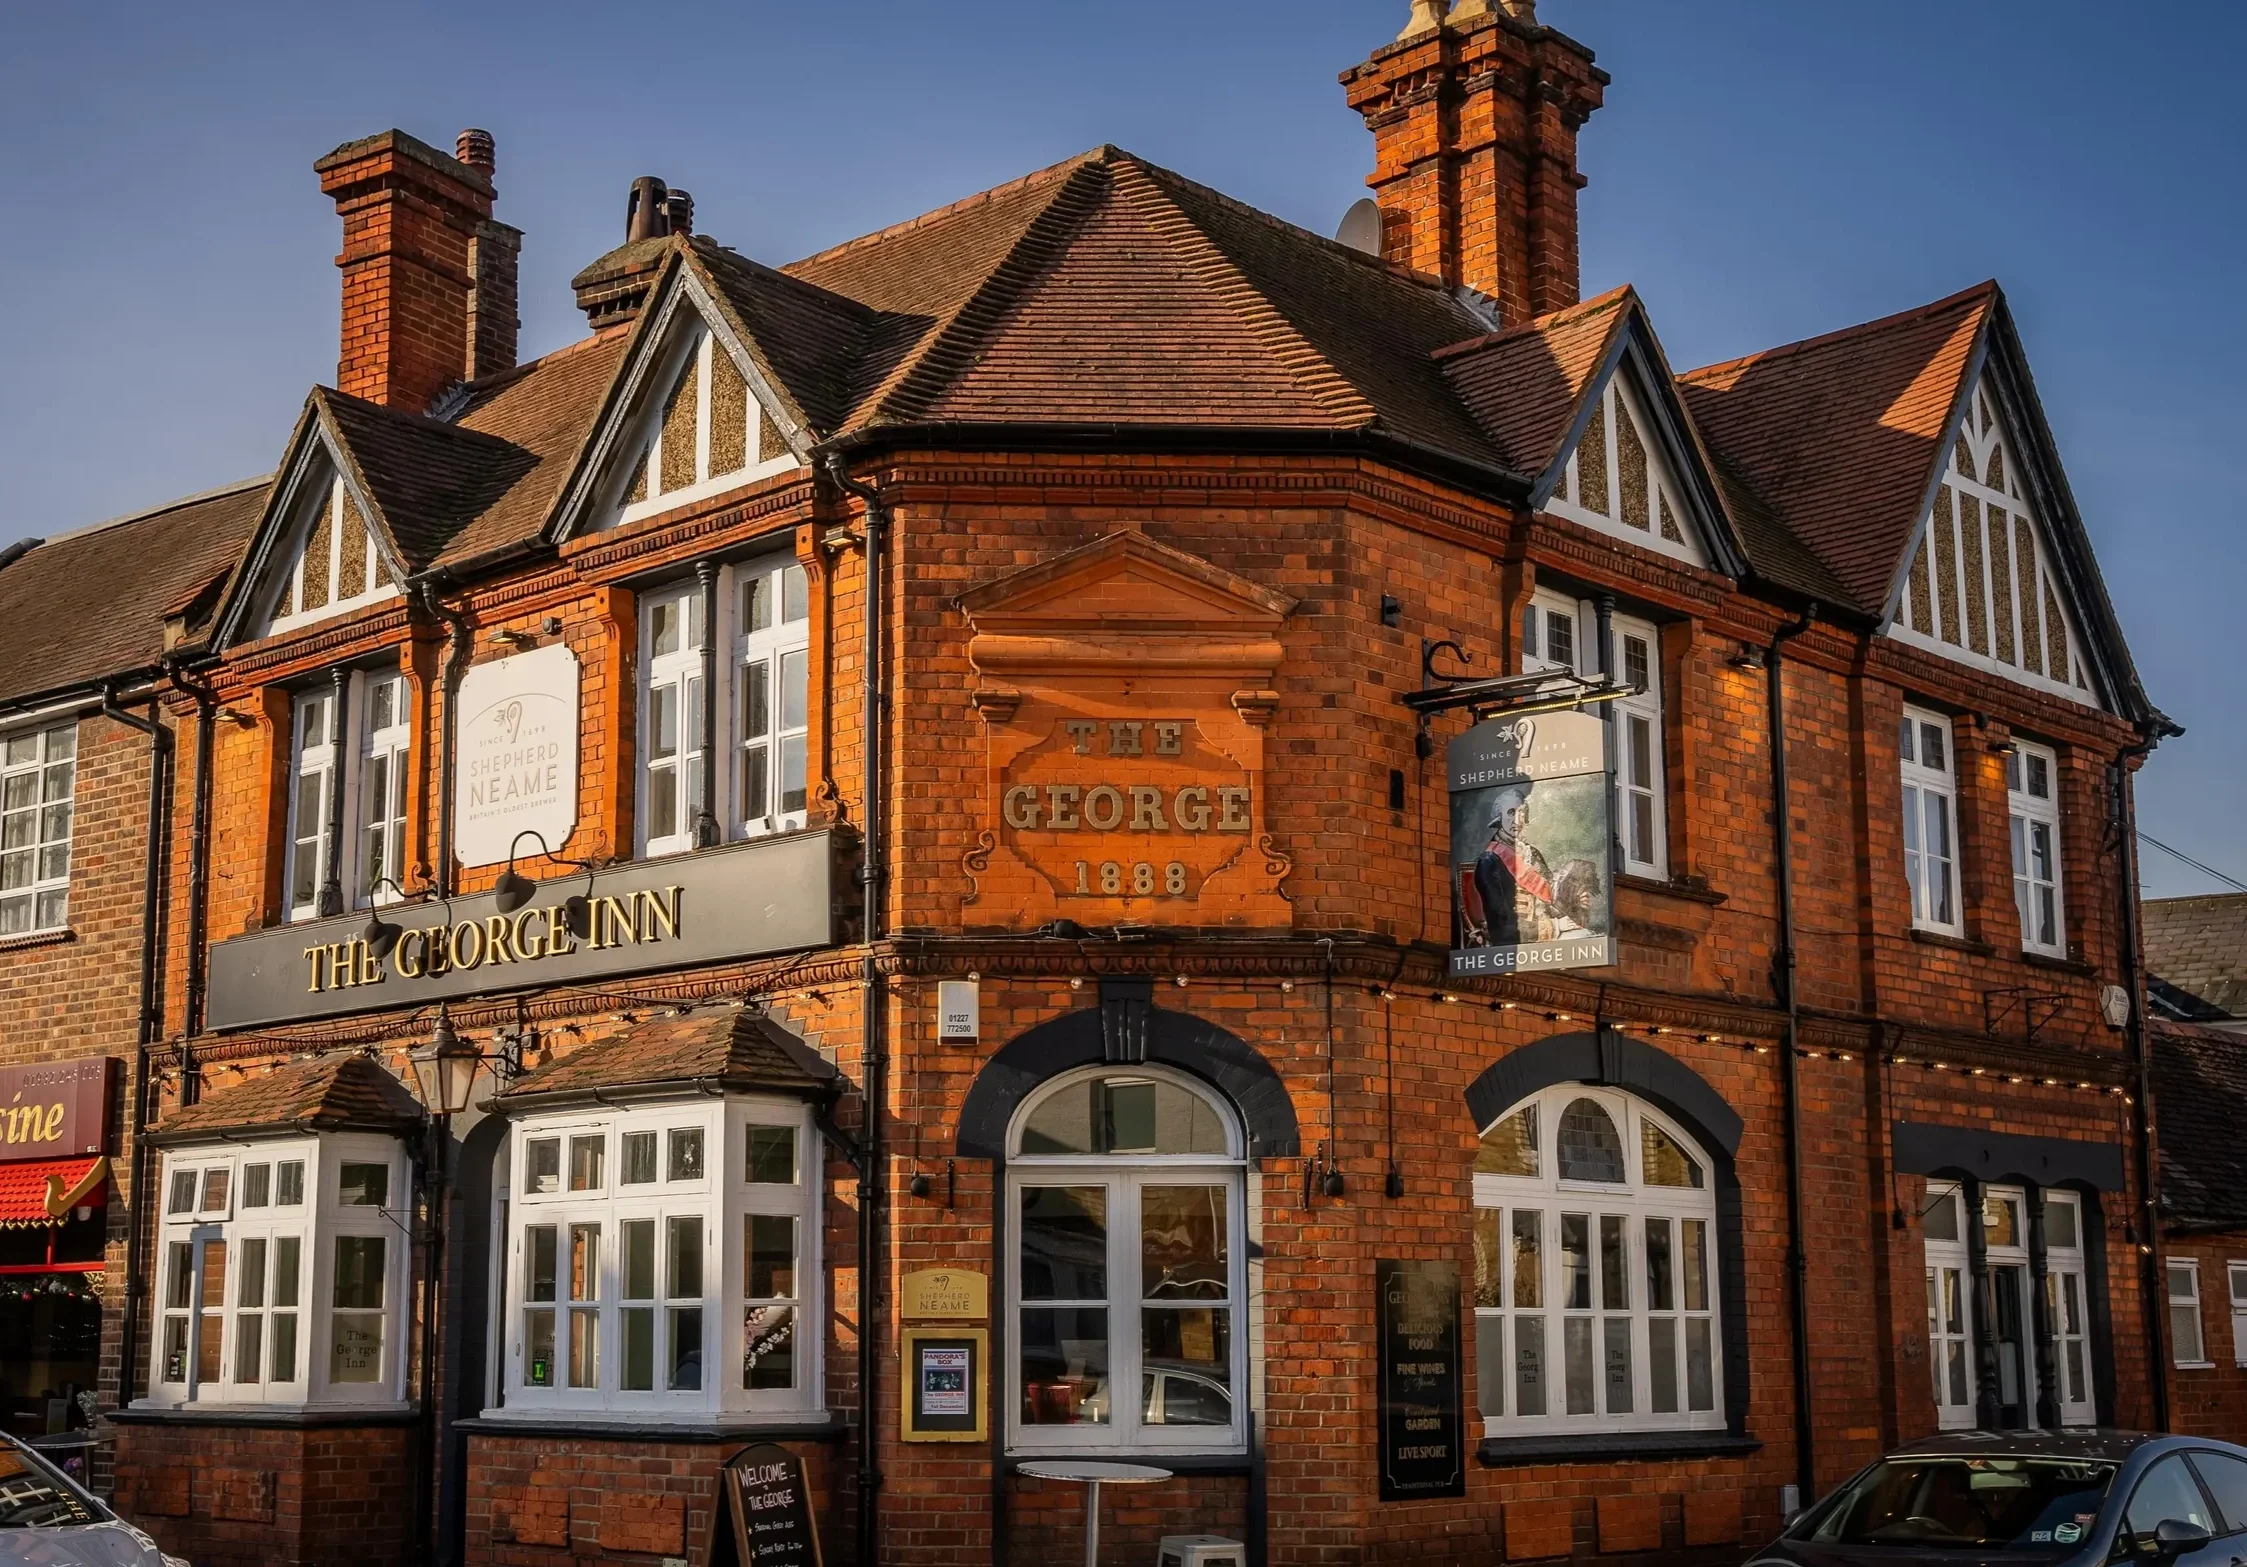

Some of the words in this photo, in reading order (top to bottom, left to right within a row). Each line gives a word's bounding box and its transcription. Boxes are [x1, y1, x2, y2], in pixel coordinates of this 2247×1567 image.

[479, 735, 504, 748] SINCE
[523, 725, 546, 737] 1698
[1067, 721, 1182, 755] THE
[1480, 751, 1511, 761] SINCE
[1537, 742, 1567, 753] 1698
[470, 743, 559, 777] SHEPHERD
[1459, 764, 1534, 785] SHEPHERD
[1540, 757, 1589, 774] NEAME
[470, 764, 558, 808] NEAME
[503, 802, 529, 814] OLDEST
[530, 796, 557, 809] BREWER
[1003, 785, 1250, 832] GEORGE
[1075, 860, 1187, 896] 1888
[303, 944, 387, 994] THE
[394, 904, 578, 980] GEORGE
[586, 885, 684, 951] INN
[1454, 954, 1486, 970] THE
[1493, 947, 1563, 967] GEORGE
[1572, 945, 1602, 961] INN
[948, 1014, 969, 1023] 01227
[947, 1024, 972, 1033] 772500
[920, 1292, 970, 1300] SHEPHERD
[919, 1300, 970, 1310] NEAME
[346, 1330, 368, 1341] The
[1397, 1323, 1444, 1335] DELICIOUS
[336, 1344, 377, 1357] George
[1408, 1338, 1434, 1350] FOOD
[1523, 1349, 1536, 1359] The
[1611, 1350, 1624, 1359] The
[346, 1357, 367, 1368] Inn
[1397, 1363, 1417, 1375] FINE
[1418, 1362, 1446, 1375] WINES
[1523, 1373, 1537, 1383] Inn
[1612, 1373, 1624, 1383] Inn
[1405, 1418, 1441, 1431] GARDEN
[1398, 1447, 1419, 1460] LIVE
[1420, 1445, 1447, 1459] SPORT
[748, 1496, 764, 1511] THE
[763, 1489, 795, 1508] GEORGE
